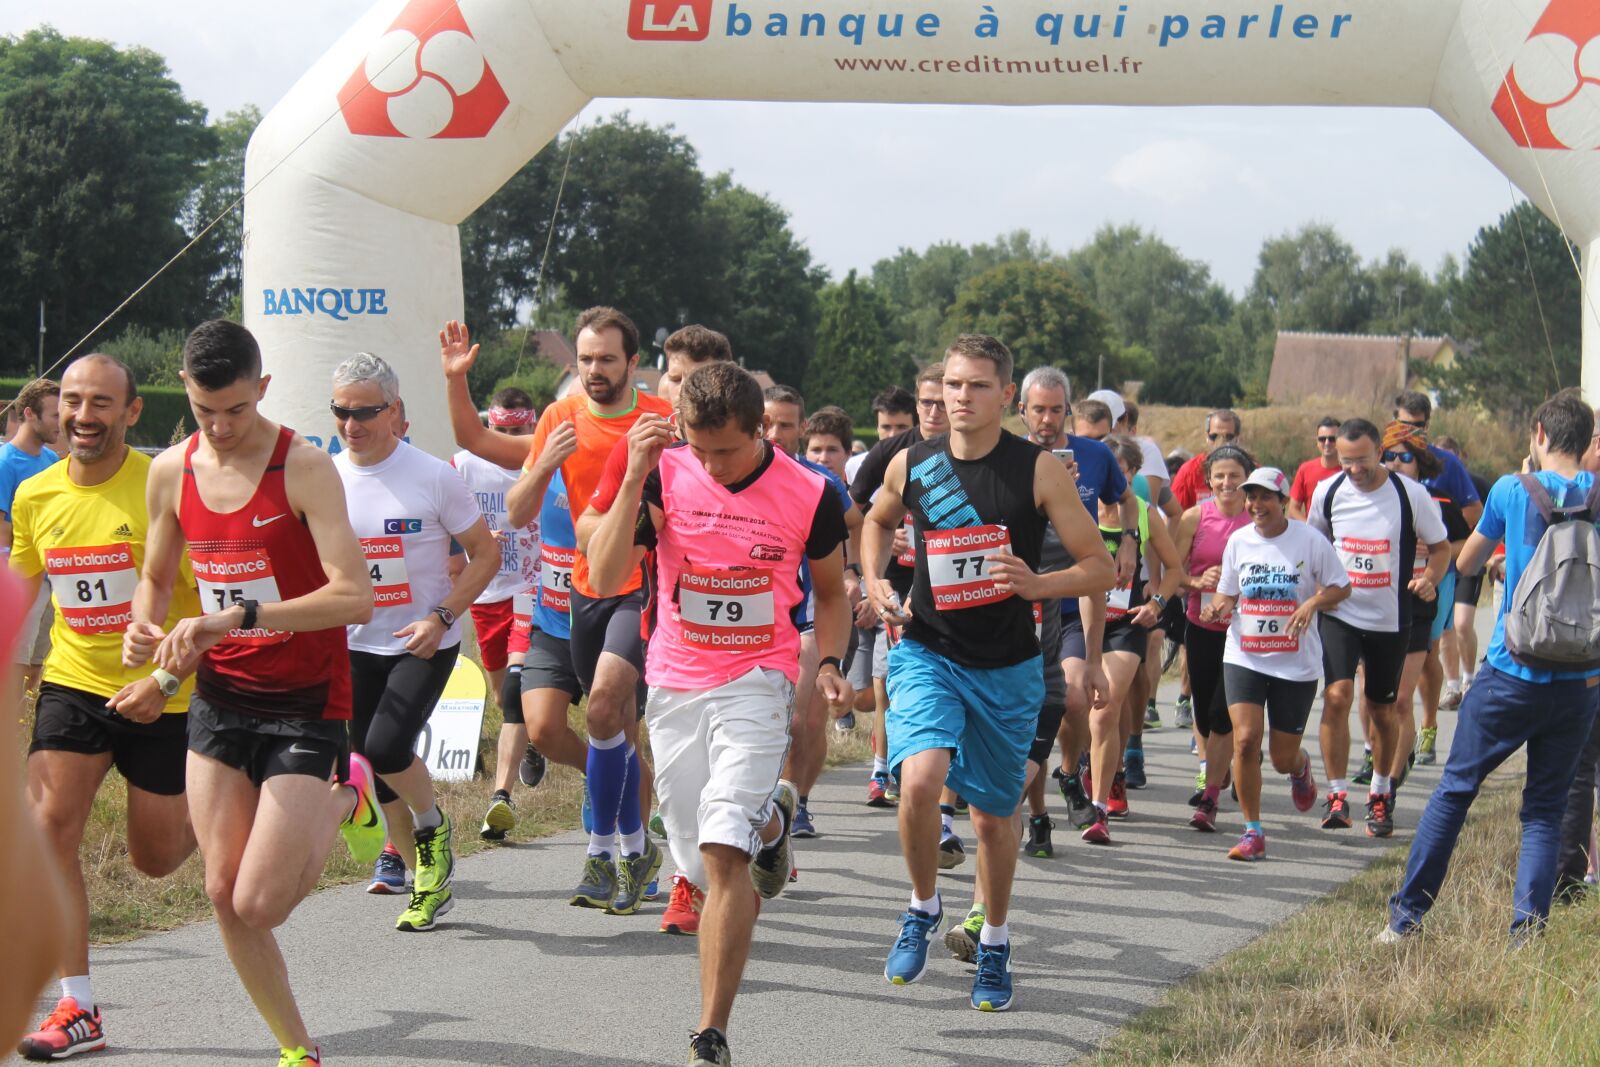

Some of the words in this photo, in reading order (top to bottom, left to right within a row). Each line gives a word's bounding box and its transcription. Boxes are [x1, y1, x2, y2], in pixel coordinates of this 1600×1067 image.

[642, 4, 699, 32] LA
[726, 4, 941, 45] banque
[974, 6, 999, 38] à
[1035, 6, 1128, 45] qui
[1159, 5, 1352, 47] parler
[834, 55, 1143, 75] www.creditmutuel.fr
[263, 287, 389, 321] BANQUE
[475, 492, 507, 513] TRAIL
[387, 521, 419, 532] CIC
[928, 537, 950, 549] new
[952, 531, 1006, 547] balance
[1356, 542, 1388, 551] balance
[361, 544, 400, 554] alance
[553, 551, 575, 563] bala
[47, 557, 72, 568] new
[73, 552, 129, 567] balance
[209, 559, 267, 575] balance
[952, 556, 985, 579] 77
[1354, 557, 1374, 571] 56
[553, 571, 572, 588] 78
[682, 573, 710, 587] new
[711, 575, 769, 589] balance
[1272, 573, 1300, 584] FERME
[1356, 576, 1389, 585] balance
[76, 578, 108, 603] 81
[374, 590, 408, 601] lance
[937, 593, 961, 604] new
[212, 588, 244, 610] 75
[1242, 603, 1258, 611] new
[1258, 602, 1295, 612] balance
[65, 617, 86, 627] new
[86, 611, 133, 627] balanc
[706, 600, 744, 622] 79
[1256, 619, 1279, 633] 76
[683, 630, 710, 644] new
[711, 632, 771, 646] balance
[1241, 641, 1259, 649] new
[1260, 639, 1297, 649] balance
[437, 739, 471, 770] km
